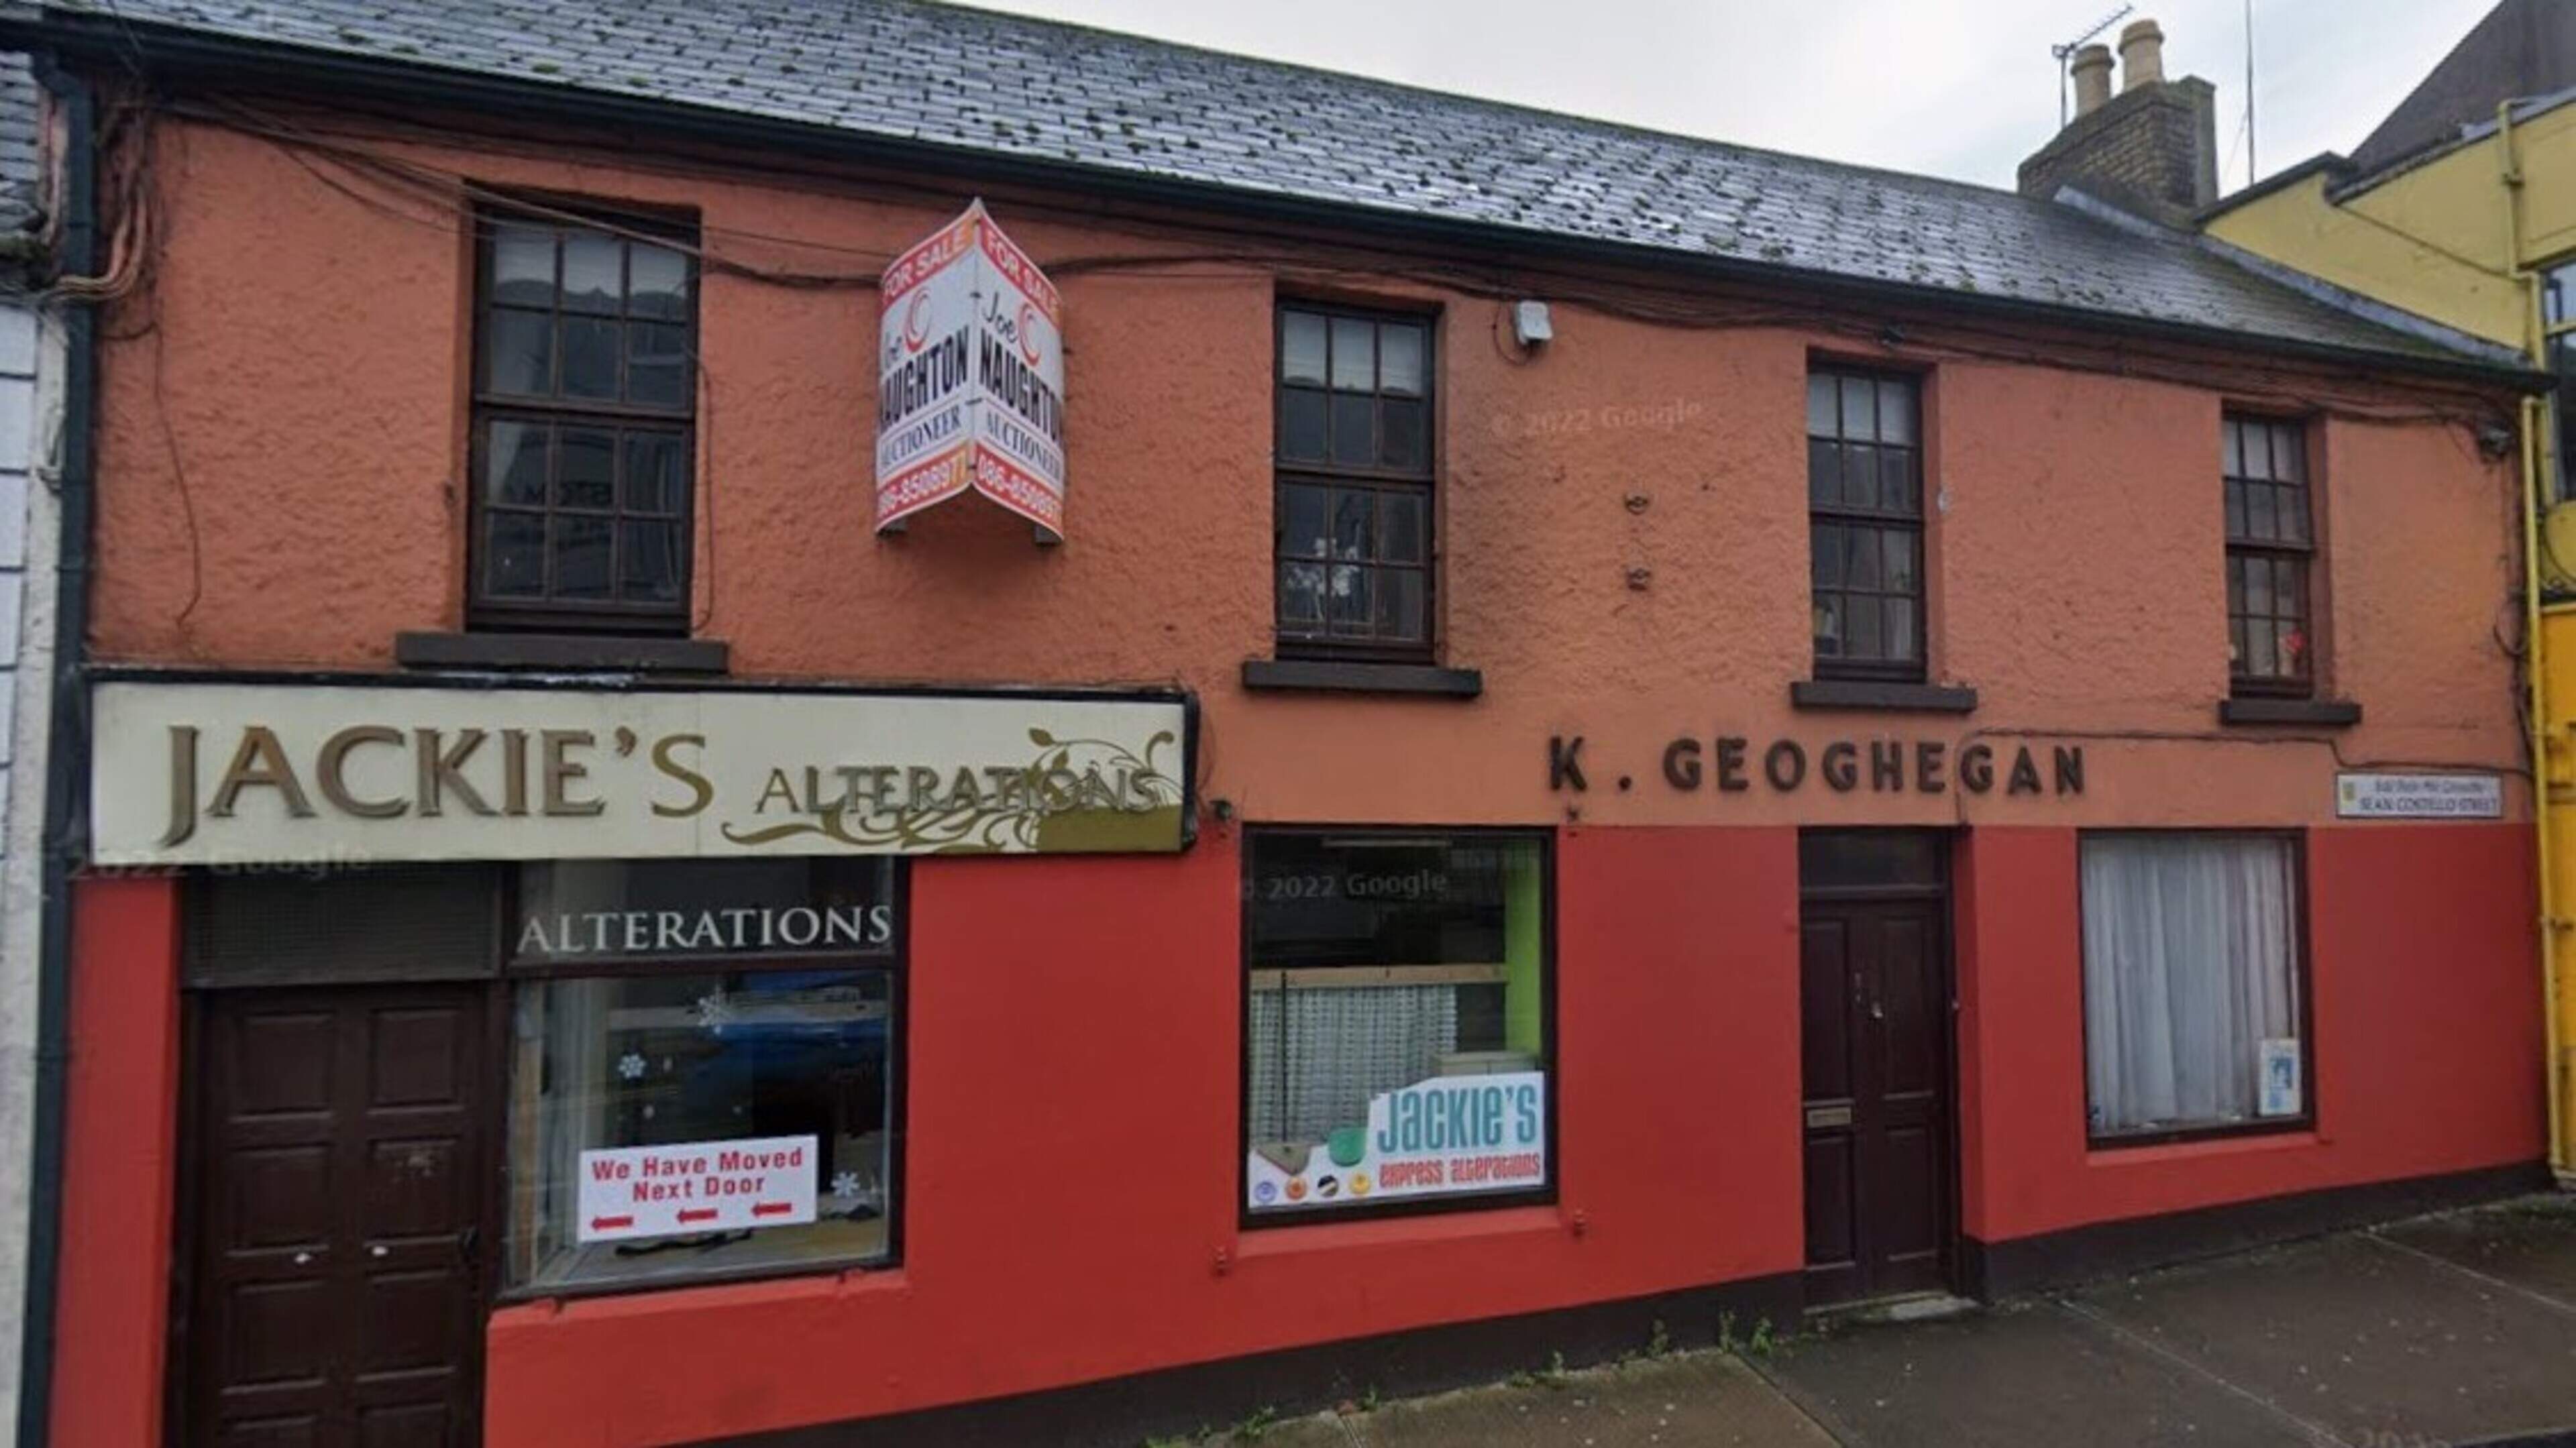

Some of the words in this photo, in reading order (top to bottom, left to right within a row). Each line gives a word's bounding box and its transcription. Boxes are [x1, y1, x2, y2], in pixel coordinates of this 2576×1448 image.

[915, 223, 968, 277] SALE
[986, 229, 1023, 284] FOR
[982, 291, 1018, 343] Joe
[880, 325, 968, 433] AUGHTON
[979, 327, 1064, 450] NAUGHTO
[159, 724, 715, 848] JACKIE'S
[755, 765, 1163, 813] ALTERATIONS
[1662, 737, 2085, 794] GEOGHEGAN
[517, 905, 892, 954] ALTERATIONS
[592, 1161, 631, 1181] We
[642, 1156, 708, 1177] Have
[719, 1146, 803, 1172] Moved
[633, 1179, 693, 1202] Next
[705, 1175, 765, 1197] Door
